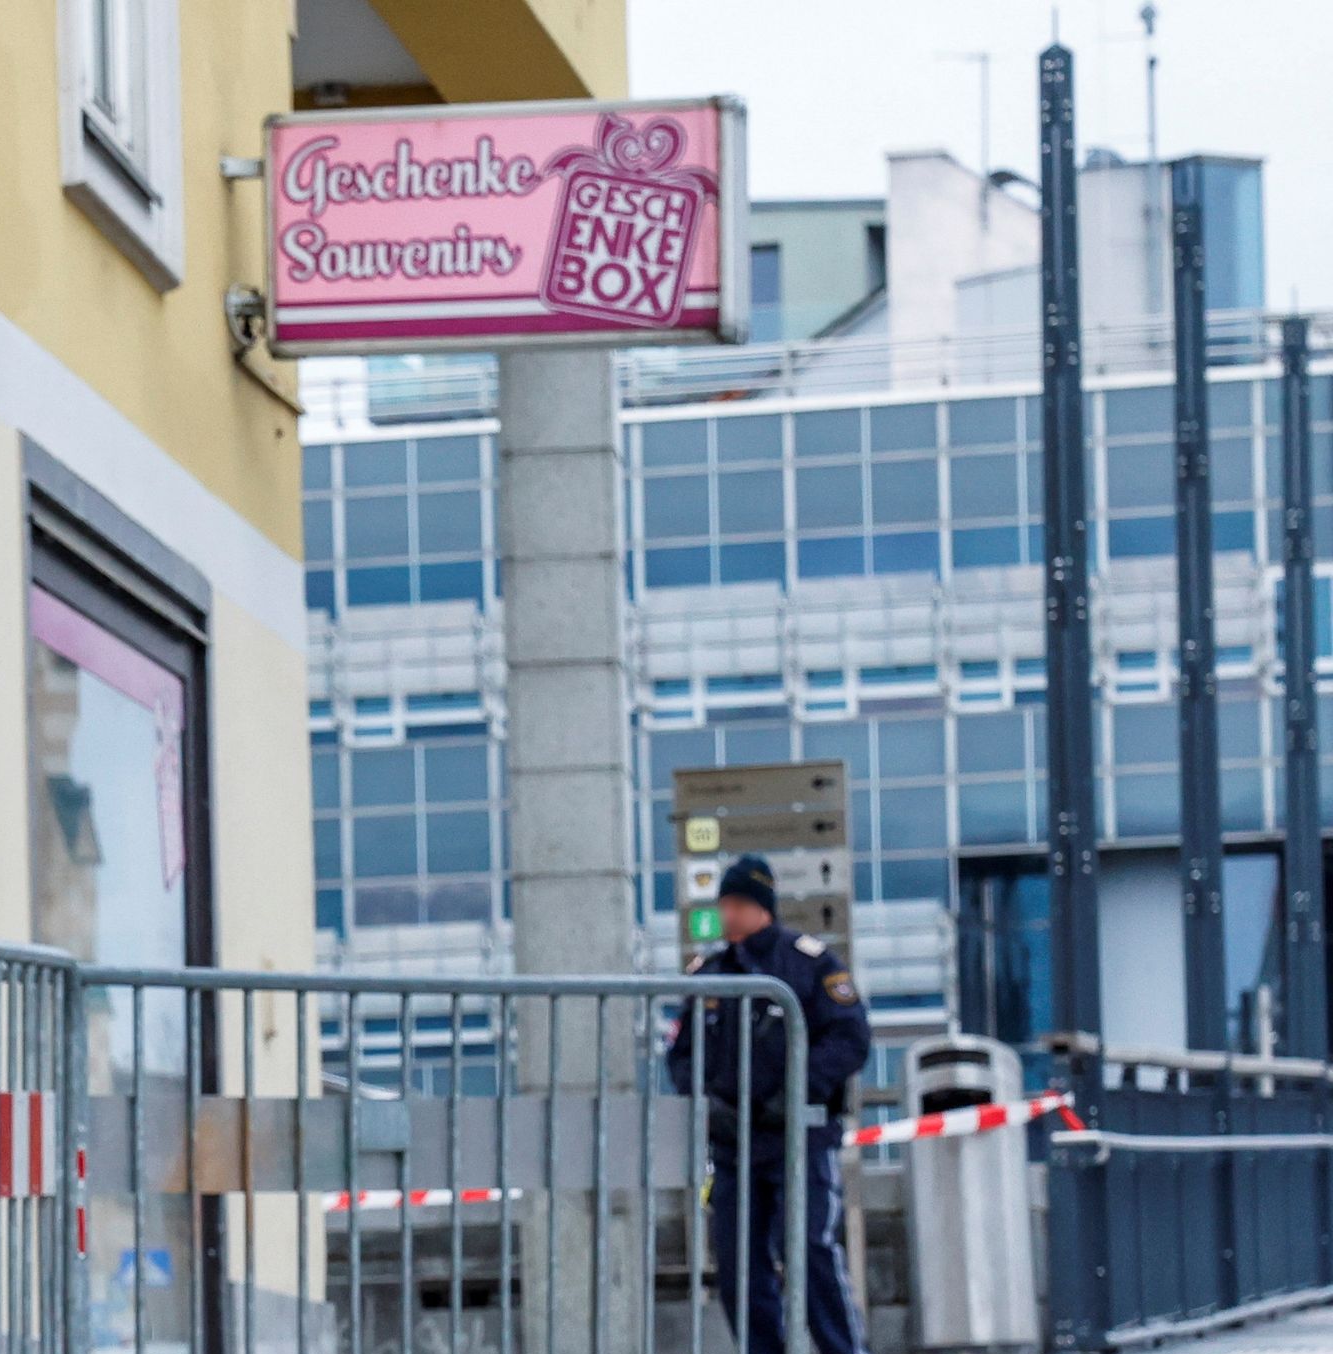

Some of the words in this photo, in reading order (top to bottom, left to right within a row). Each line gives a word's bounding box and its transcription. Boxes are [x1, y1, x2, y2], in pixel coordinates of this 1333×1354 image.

[284, 134, 541, 217] Geschenke
[575, 181, 687, 226] GESCH
[282, 221, 522, 282] Souvenirs
[567, 214, 684, 266] ENKE
[556, 255, 671, 316] BOX
